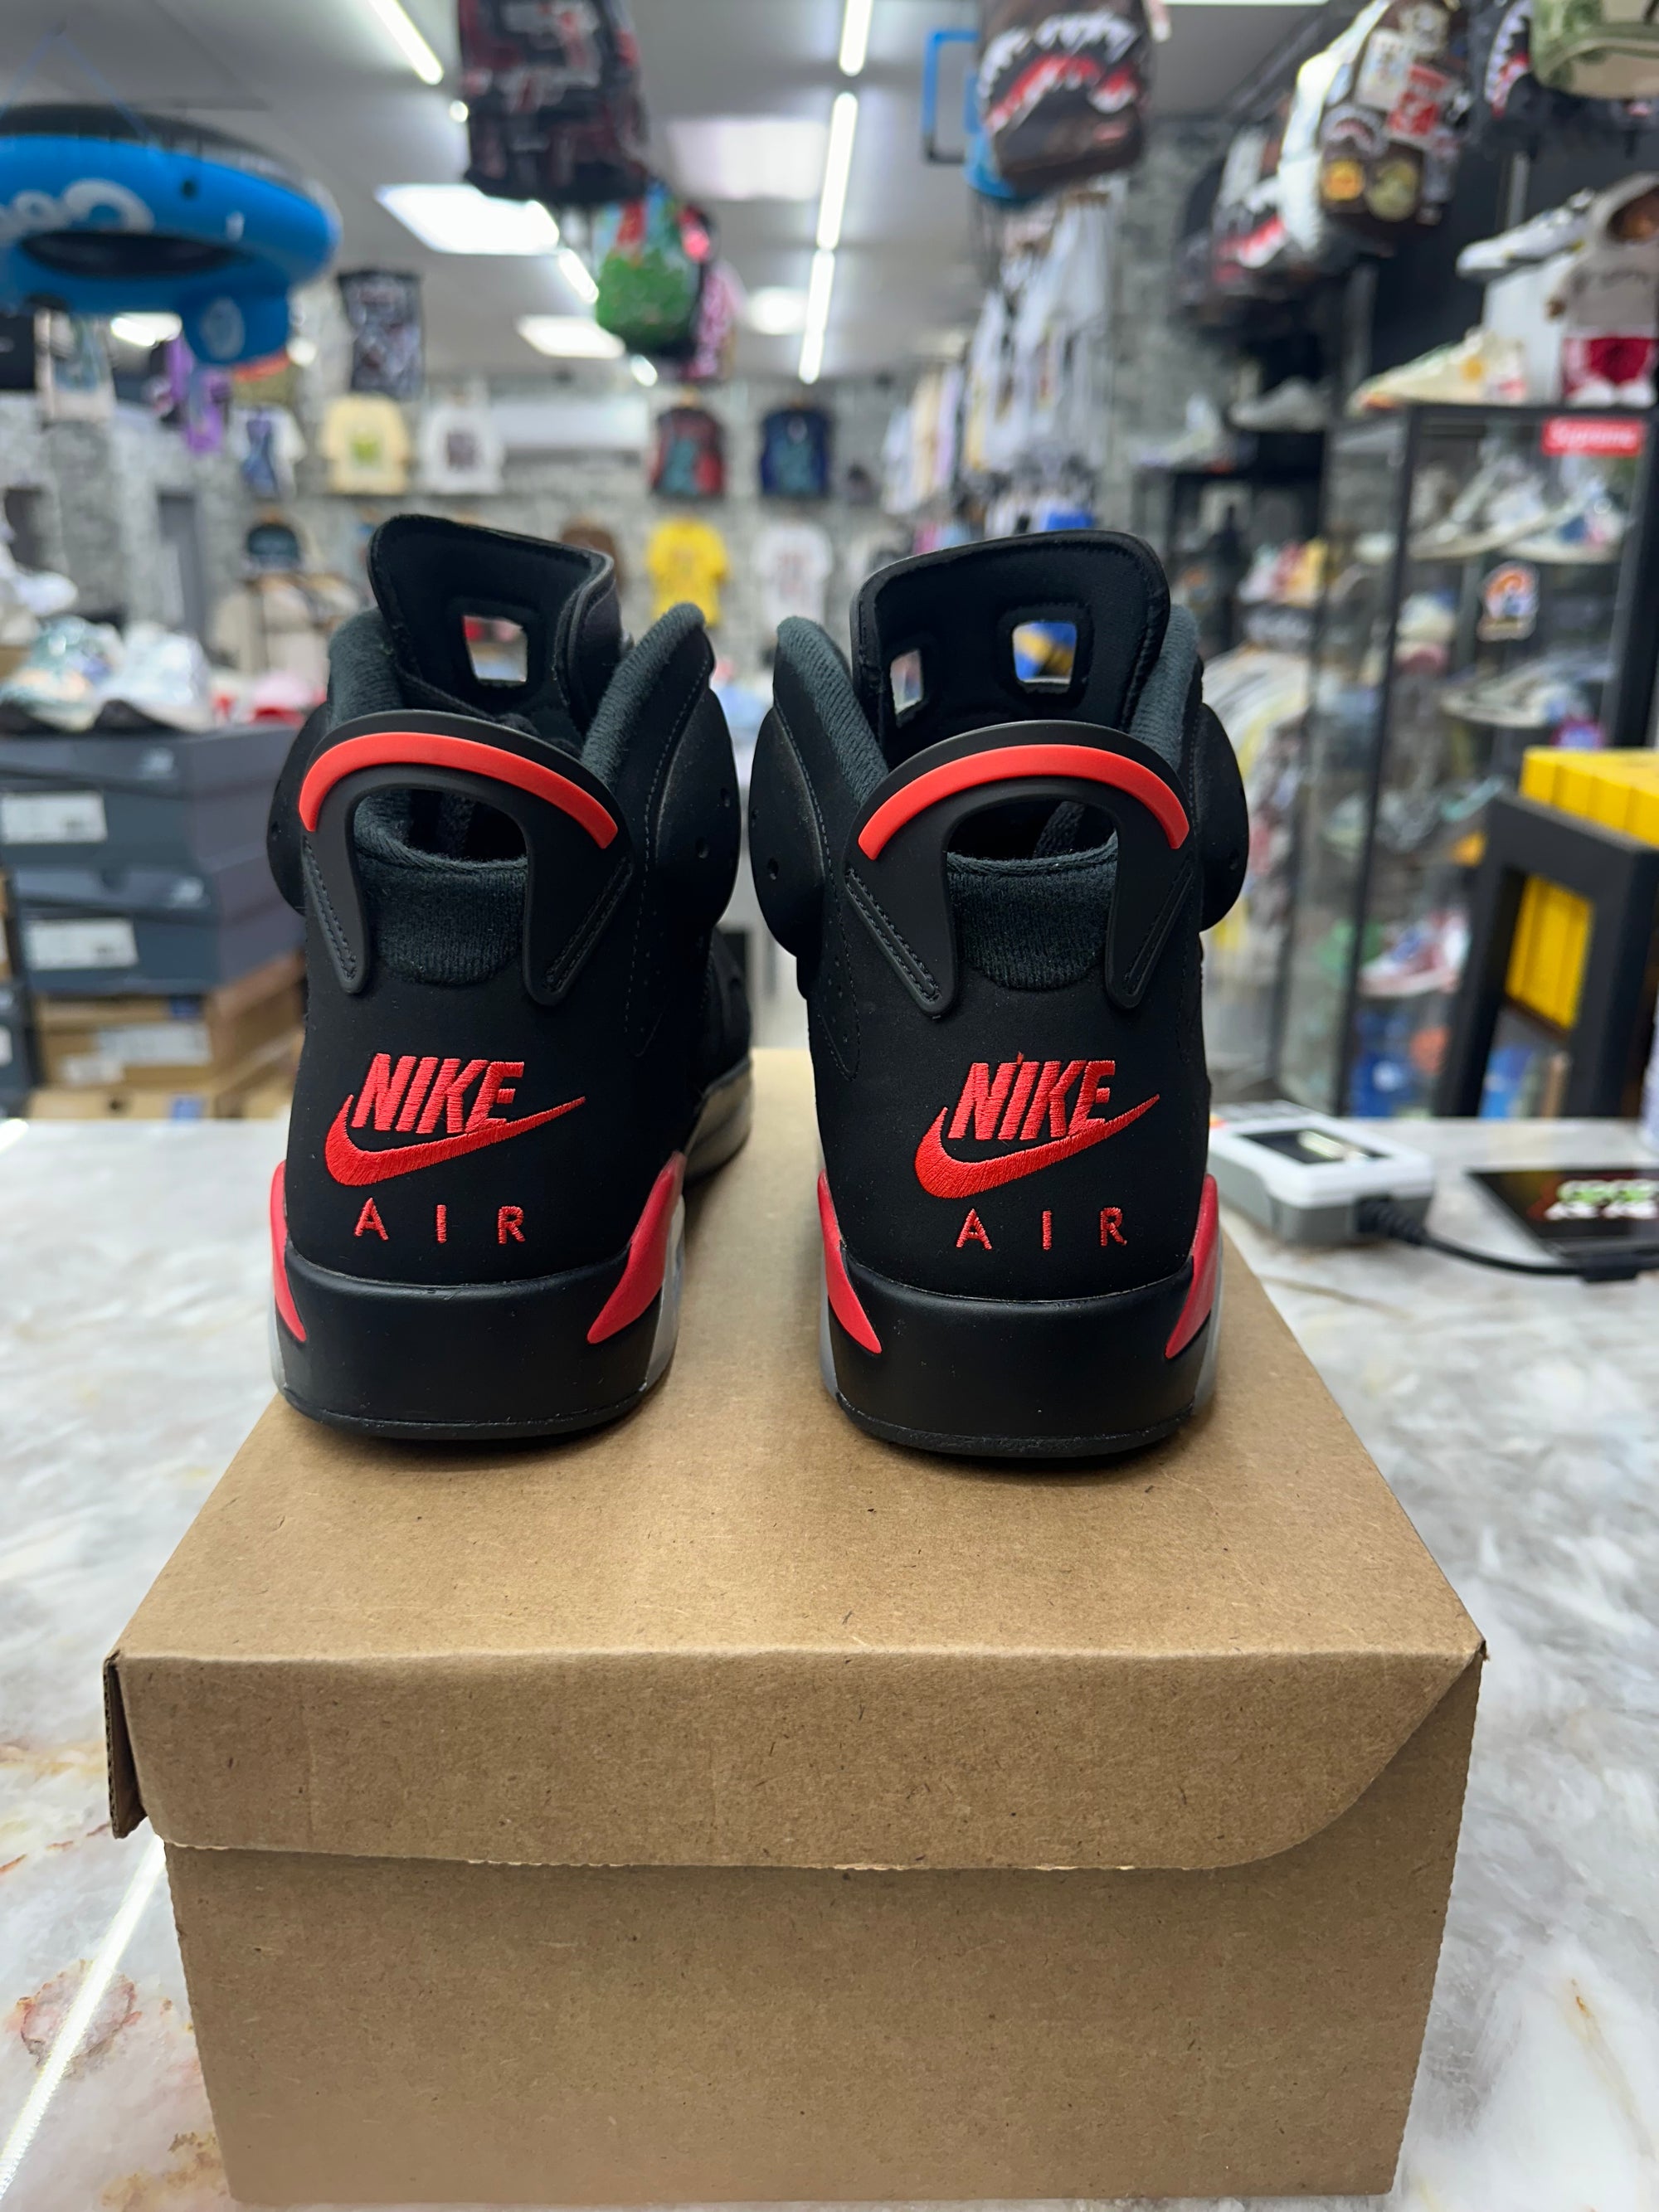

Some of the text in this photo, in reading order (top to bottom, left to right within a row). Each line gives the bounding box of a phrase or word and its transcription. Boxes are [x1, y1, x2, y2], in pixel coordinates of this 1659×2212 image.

[351, 1053, 525, 1134] NIKE
[947, 1059, 1116, 1141] NIKE
[354, 1197, 526, 1244] AIR
[956, 1208, 1128, 1251] AIR
